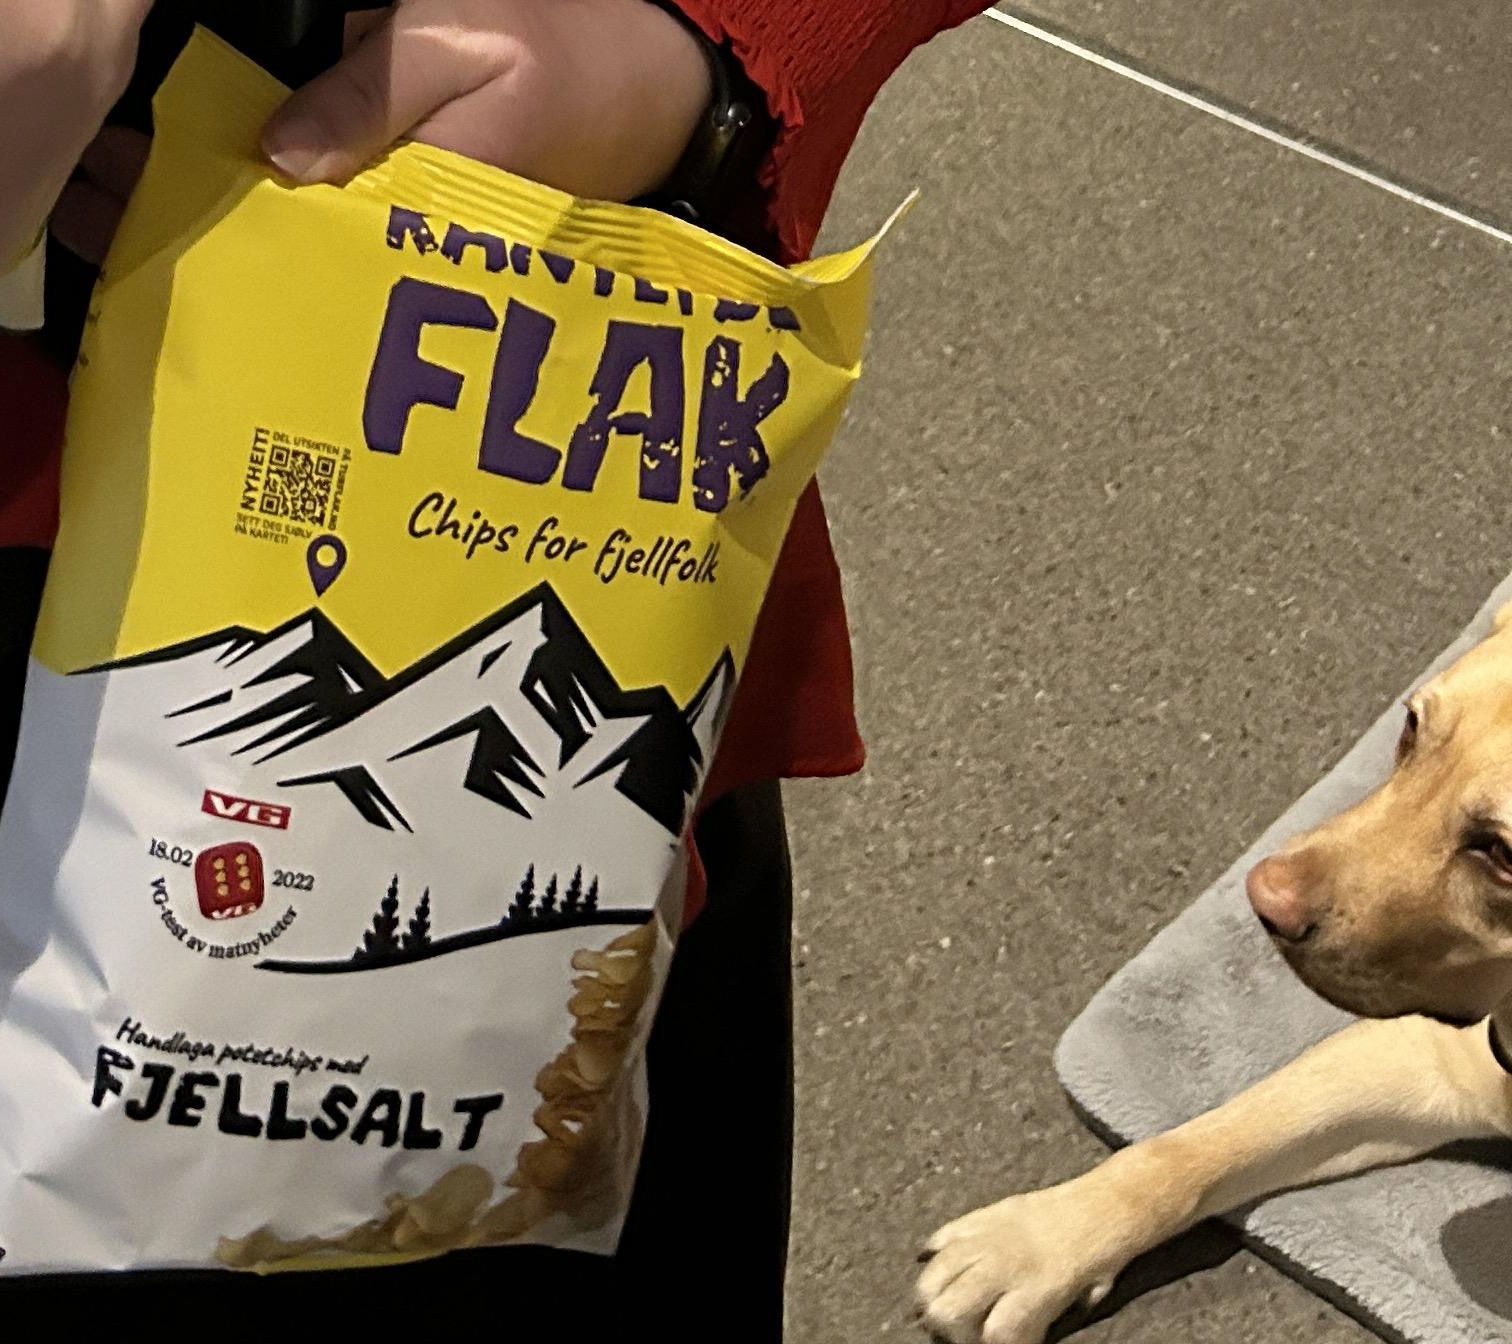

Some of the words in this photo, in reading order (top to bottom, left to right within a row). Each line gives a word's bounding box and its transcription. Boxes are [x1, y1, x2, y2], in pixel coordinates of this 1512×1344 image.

[362, 275, 790, 513] FLAK
[241, 427, 270, 511] NYHEIT!
[407, 493, 519, 560] Chips
[525, 517, 588, 565] for
[595, 529, 721, 586] fjellfolk
[210, 794, 284, 826] VG
[148, 837, 194, 868] 18.02
[272, 869, 316, 892] 2022
[186, 936, 208, 953] av
[208, 905, 298, 960] matnyheter
[116, 1017, 215, 1061] Handlaga
[216, 1042, 324, 1076] potetchips
[325, 1055, 370, 1075] med
[91, 1045, 505, 1151] FJELLSALT
